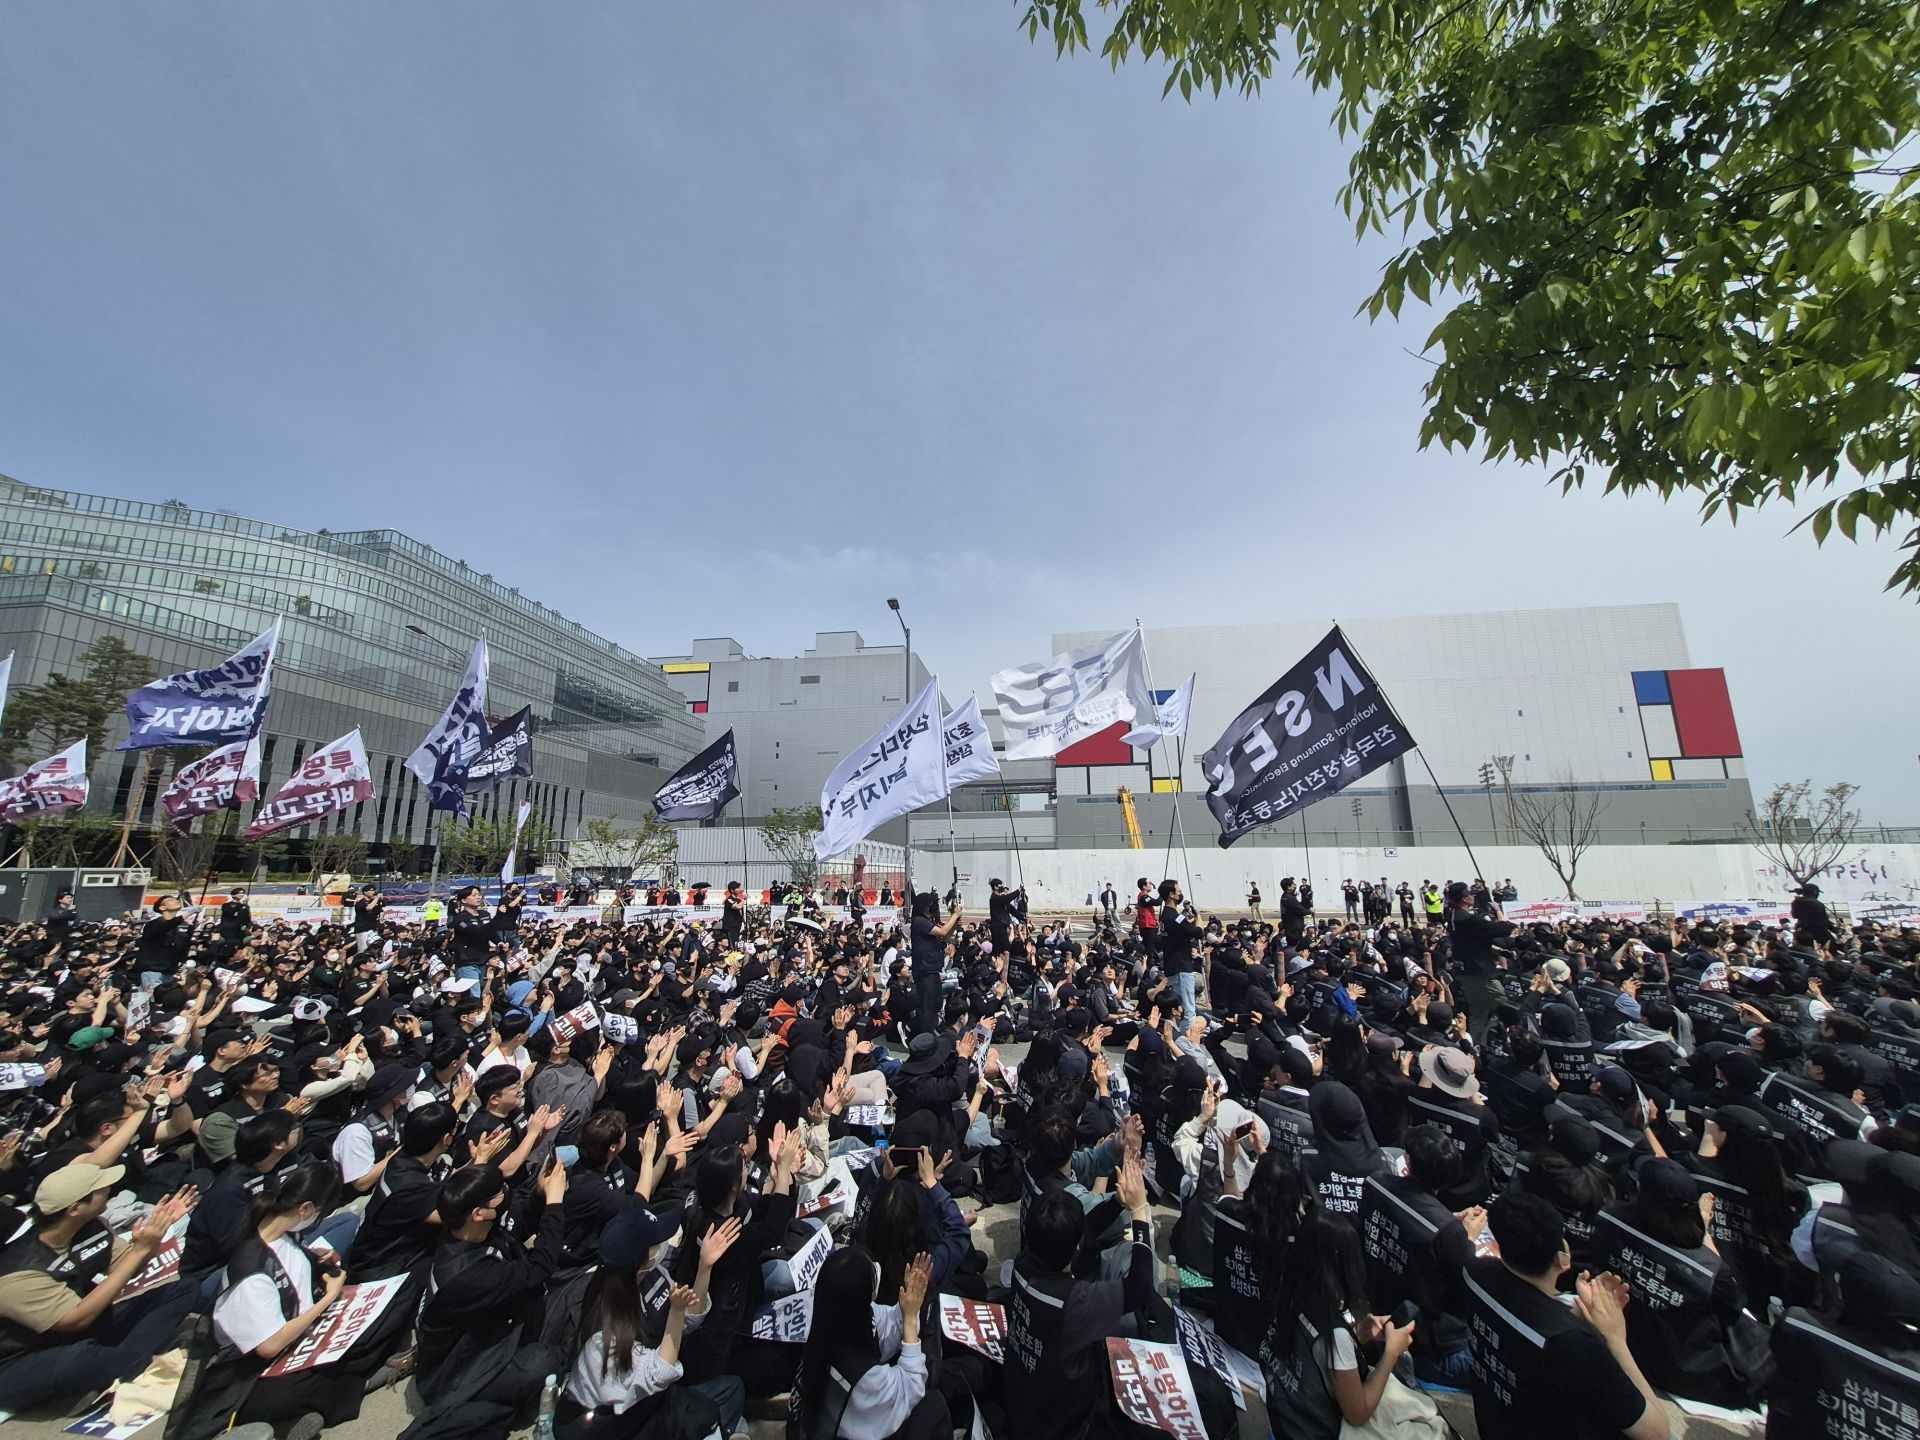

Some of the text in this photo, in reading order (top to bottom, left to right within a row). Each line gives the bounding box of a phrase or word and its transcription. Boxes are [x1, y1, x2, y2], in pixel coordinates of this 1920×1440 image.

[1319, 1182, 1345, 1198] 초기업
[1325, 1198, 1359, 1213] 삼성전자
[1371, 1208, 1401, 1240] 삼성그룹
[1224, 1255, 1247, 1279] 초기업
[1620, 1247, 1668, 1282] 삼성그룹
[653, 1288, 670, 1311] SELU
[1230, 1273, 1262, 1300] 삼성전자
[1634, 1270, 1684, 1308] 노동조합
[1815, 1388, 1866, 1428] 초기업
[1842, 1378, 1920, 1430] 삼성그룹
